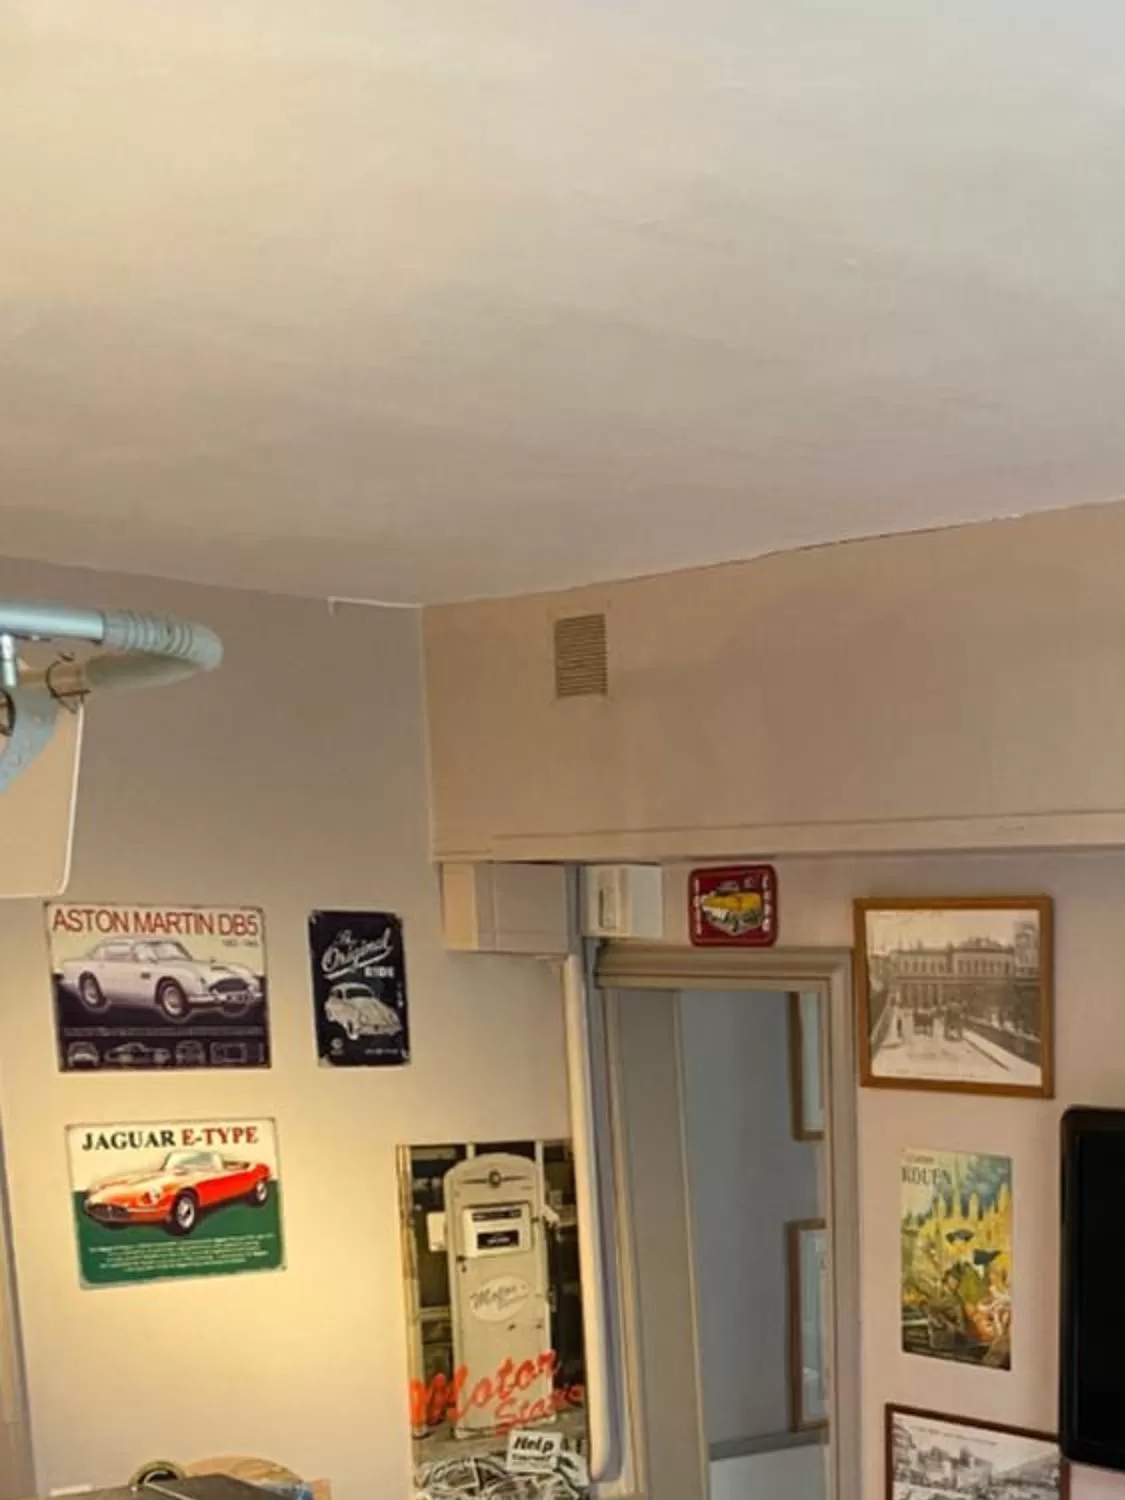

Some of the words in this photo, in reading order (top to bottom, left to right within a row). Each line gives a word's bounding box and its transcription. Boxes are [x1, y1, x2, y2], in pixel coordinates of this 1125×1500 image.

[52, 908, 129, 934] ASTON
[134, 911, 213, 936] MARTIN
[218, 913, 258, 937] DB5
[321, 928, 394, 973] Original
[82, 1129, 176, 1151] JAGUAR
[181, 1126, 259, 1147] E-TYPE
[409, 1349, 556, 1429] Motor
[513, 1437, 554, 1454] Help
